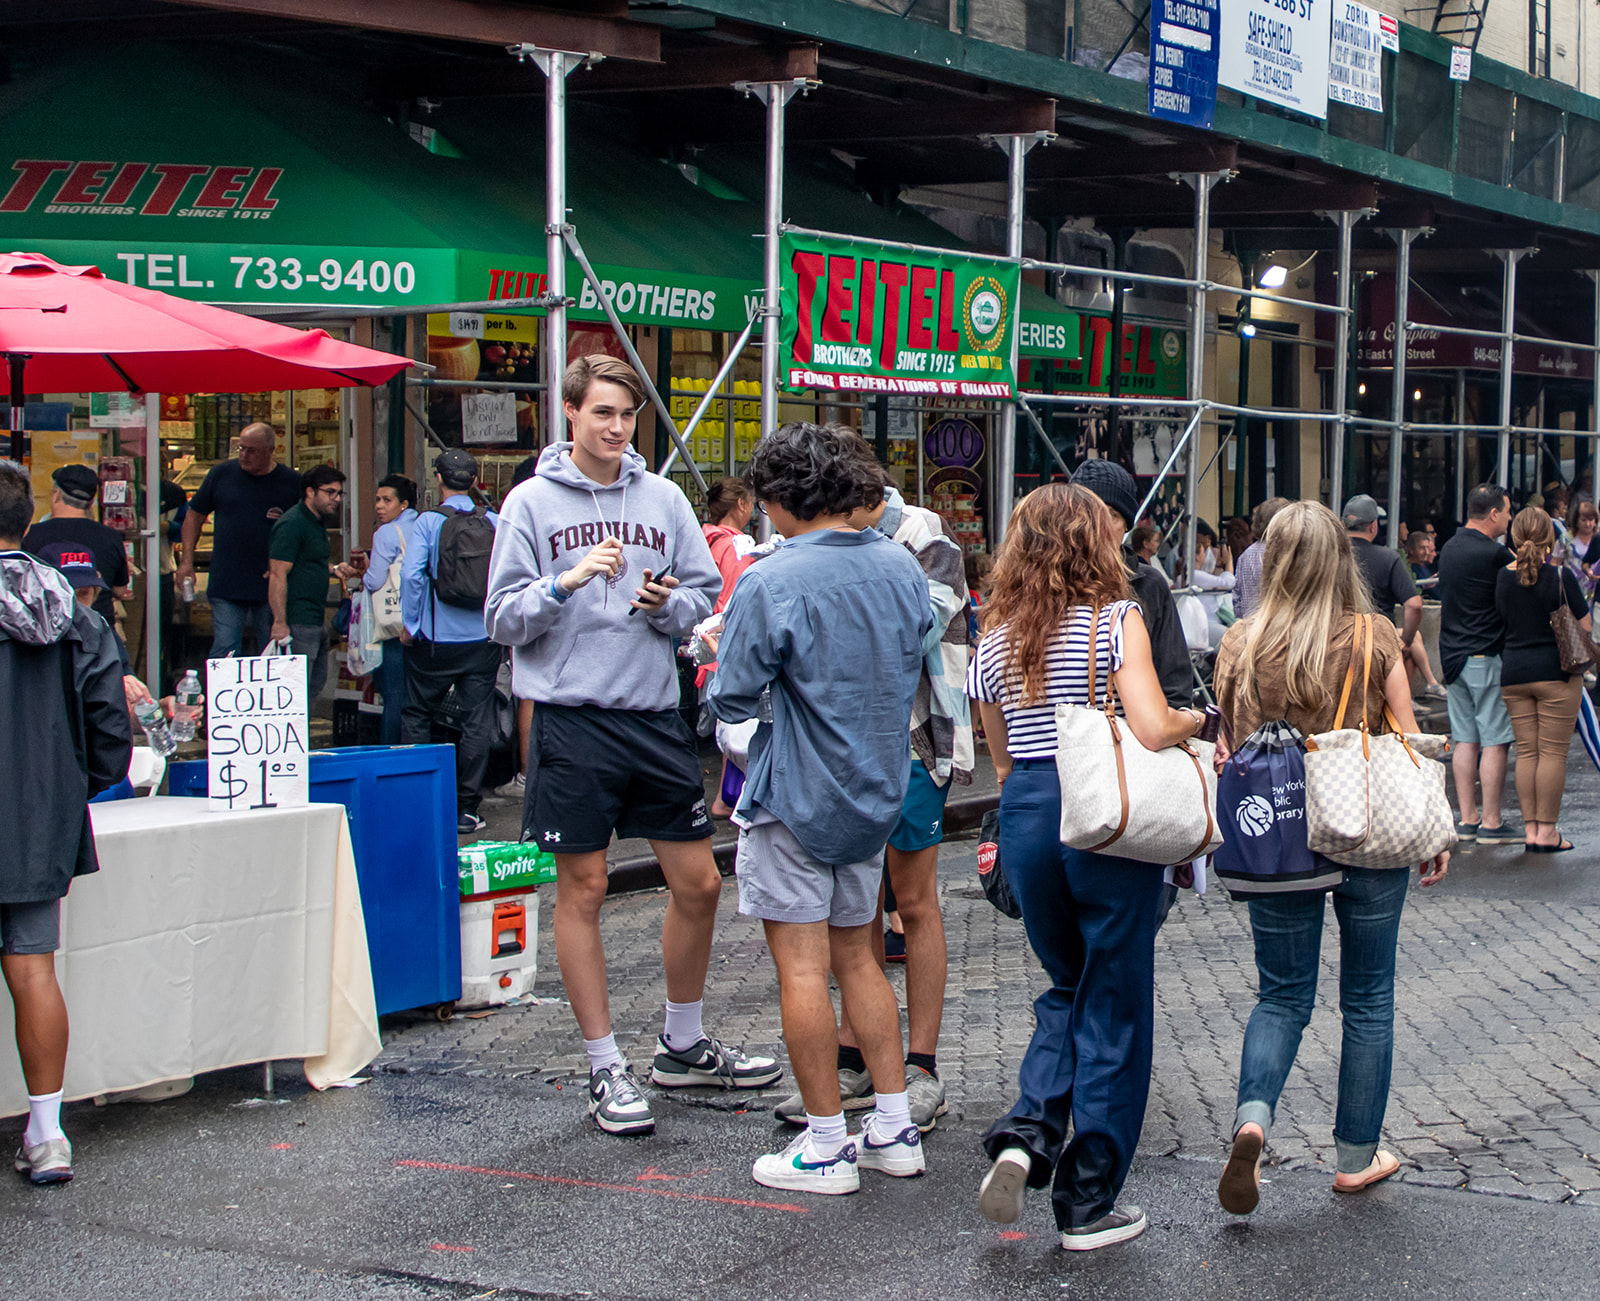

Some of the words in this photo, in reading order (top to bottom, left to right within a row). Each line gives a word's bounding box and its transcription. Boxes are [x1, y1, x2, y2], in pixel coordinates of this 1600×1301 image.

[1299, 0, 1313, 21] ST
[1345, 4, 1369, 28] ZORIA
[0, 159, 284, 216] TEITEL
[44, 205, 136, 215] BROTHERS
[176, 208, 227, 219] SINCE
[232, 210, 272, 220] 1915
[117, 253, 214, 288] TEL.
[230, 256, 415, 294] 733-9400
[488, 269, 549, 301] TEITE
[579, 278, 716, 321] BROTHERS
[791, 249, 960, 371] TEITEL
[486, 320, 503, 330] per
[505, 320, 517, 330] lb.
[1019, 322, 1066, 349] ERIES
[813, 343, 872, 367] BROTHERS
[896, 350, 926, 372] SINCE
[929, 352, 955, 374] 1915
[1365, 349, 1386, 360] East
[1406, 347, 1435, 360] Street
[791, 370, 835, 388] FOUR
[838, 375, 939, 394] GENERATIONS
[940, 381, 958, 394] OF
[960, 382, 1011, 398] QUALITY
[1034, 370, 1083, 385] BTHERS
[1105, 374, 1130, 388] SCE
[932, 422, 975, 461] 100
[548, 521, 666, 562] FORDHAM
[235, 657, 281, 684] ICE
[214, 685, 294, 713] COLD
[211, 721, 305, 756] SODA
[1271, 786, 1285, 795] ew
[1285, 778, 1306, 791] York
[1274, 796, 1292, 808] blic
[1276, 807, 1304, 821] rary
[473, 862, 486, 871] 35
[492, 855, 536, 881] Sprite
